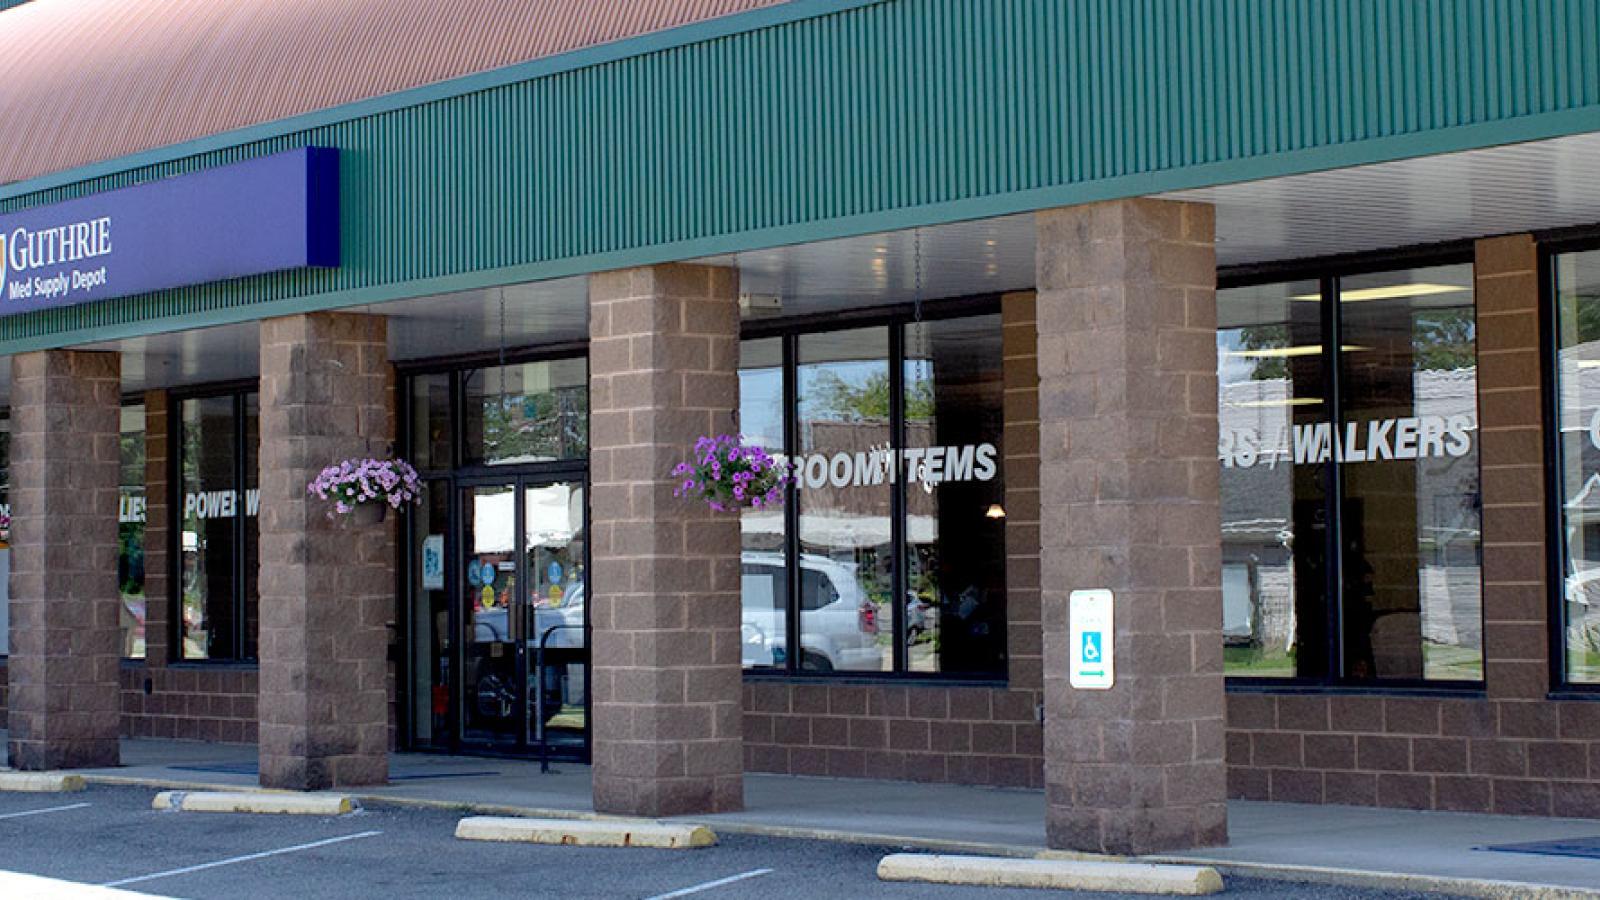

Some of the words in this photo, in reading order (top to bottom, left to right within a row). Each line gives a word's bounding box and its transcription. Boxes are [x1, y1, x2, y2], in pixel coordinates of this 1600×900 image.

[9, 216, 112, 271] GUTHRIE
[9, 277, 32, 300] Med
[34, 271, 70, 298] Supply
[72, 265, 106, 292] Depot
[1293, 415, 1471, 465] WALKERS
